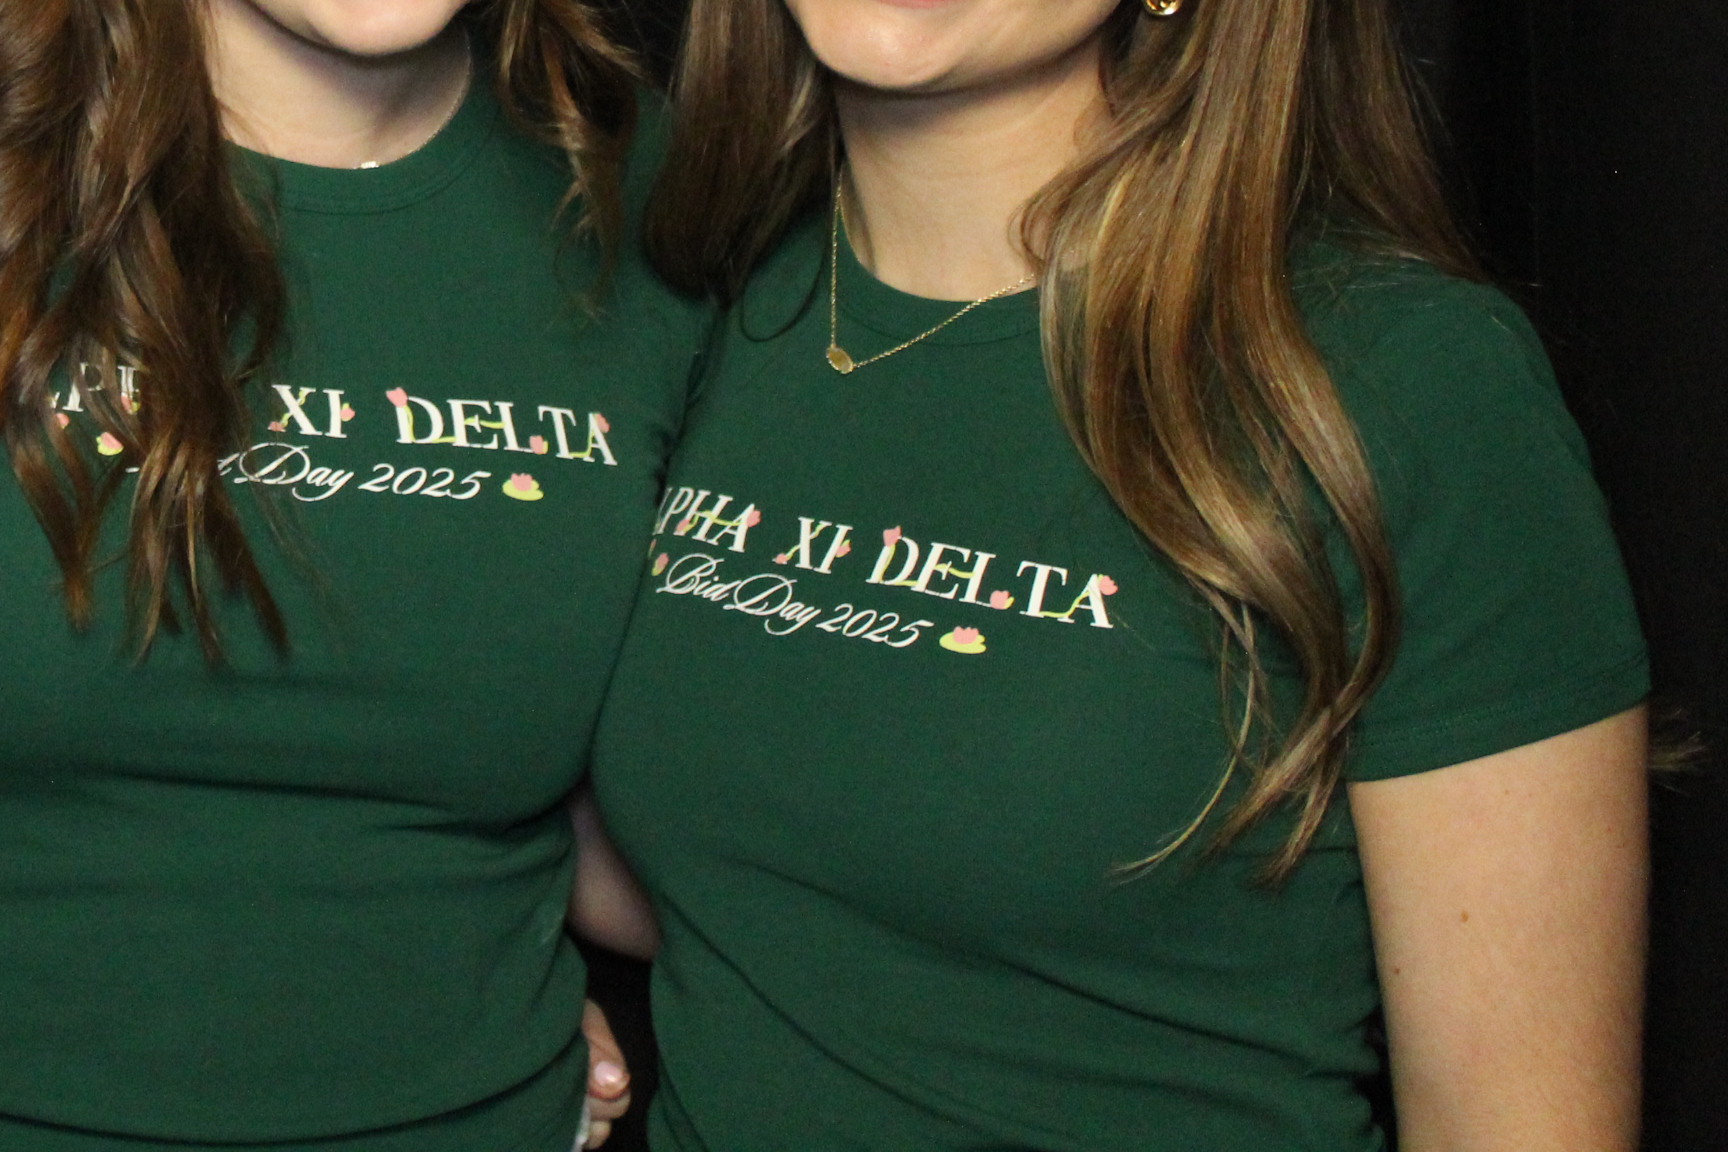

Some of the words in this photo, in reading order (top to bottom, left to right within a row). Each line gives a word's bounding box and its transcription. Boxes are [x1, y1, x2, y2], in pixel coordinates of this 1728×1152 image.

[268, 384, 356, 439] XI
[392, 393, 618, 466] DELTA
[233, 442, 355, 502] Day
[358, 463, 492, 500] 2025
[653, 486, 755, 553] PHA
[772, 516, 854, 575] XI
[865, 534, 1114, 629] DELTA
[655, 553, 743, 602] Bid
[722, 573, 822, 636] Day
[815, 603, 935, 648] 2025
